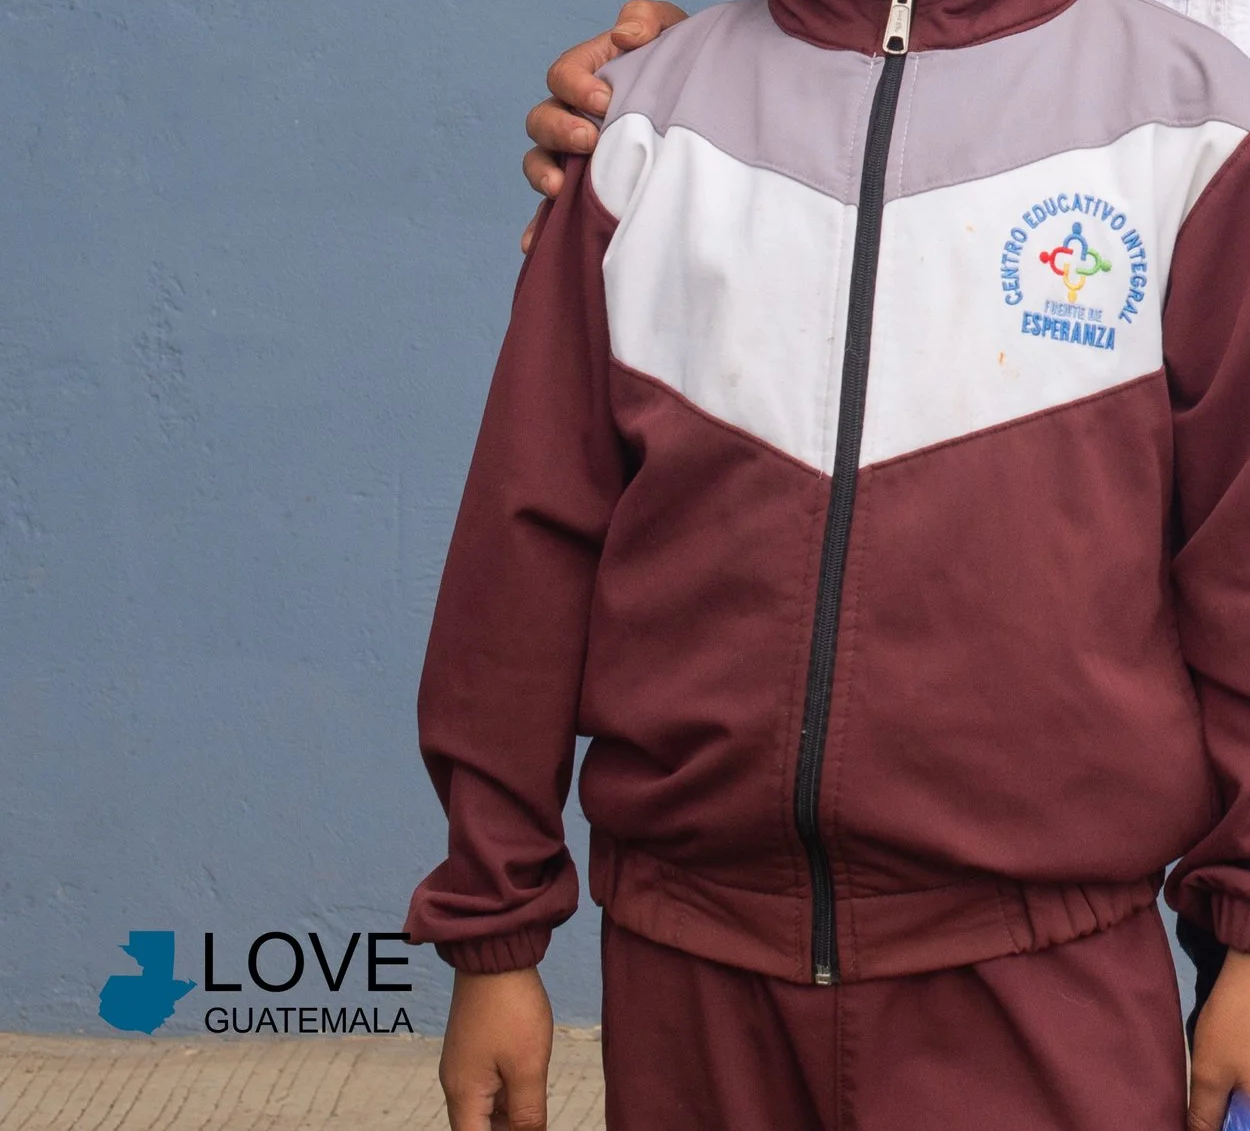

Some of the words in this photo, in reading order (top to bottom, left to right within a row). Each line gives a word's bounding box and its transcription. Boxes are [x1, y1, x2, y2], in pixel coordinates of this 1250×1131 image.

[1000, 227, 1028, 306] CENTRO
[1022, 193, 1127, 230] EDUCATIVO
[1118, 228, 1148, 324] INTEGRAL
[1021, 311, 1116, 350] ESPERANZA
[1045, 300, 1085, 319] FUENTE
[1088, 308, 1103, 322] DE
